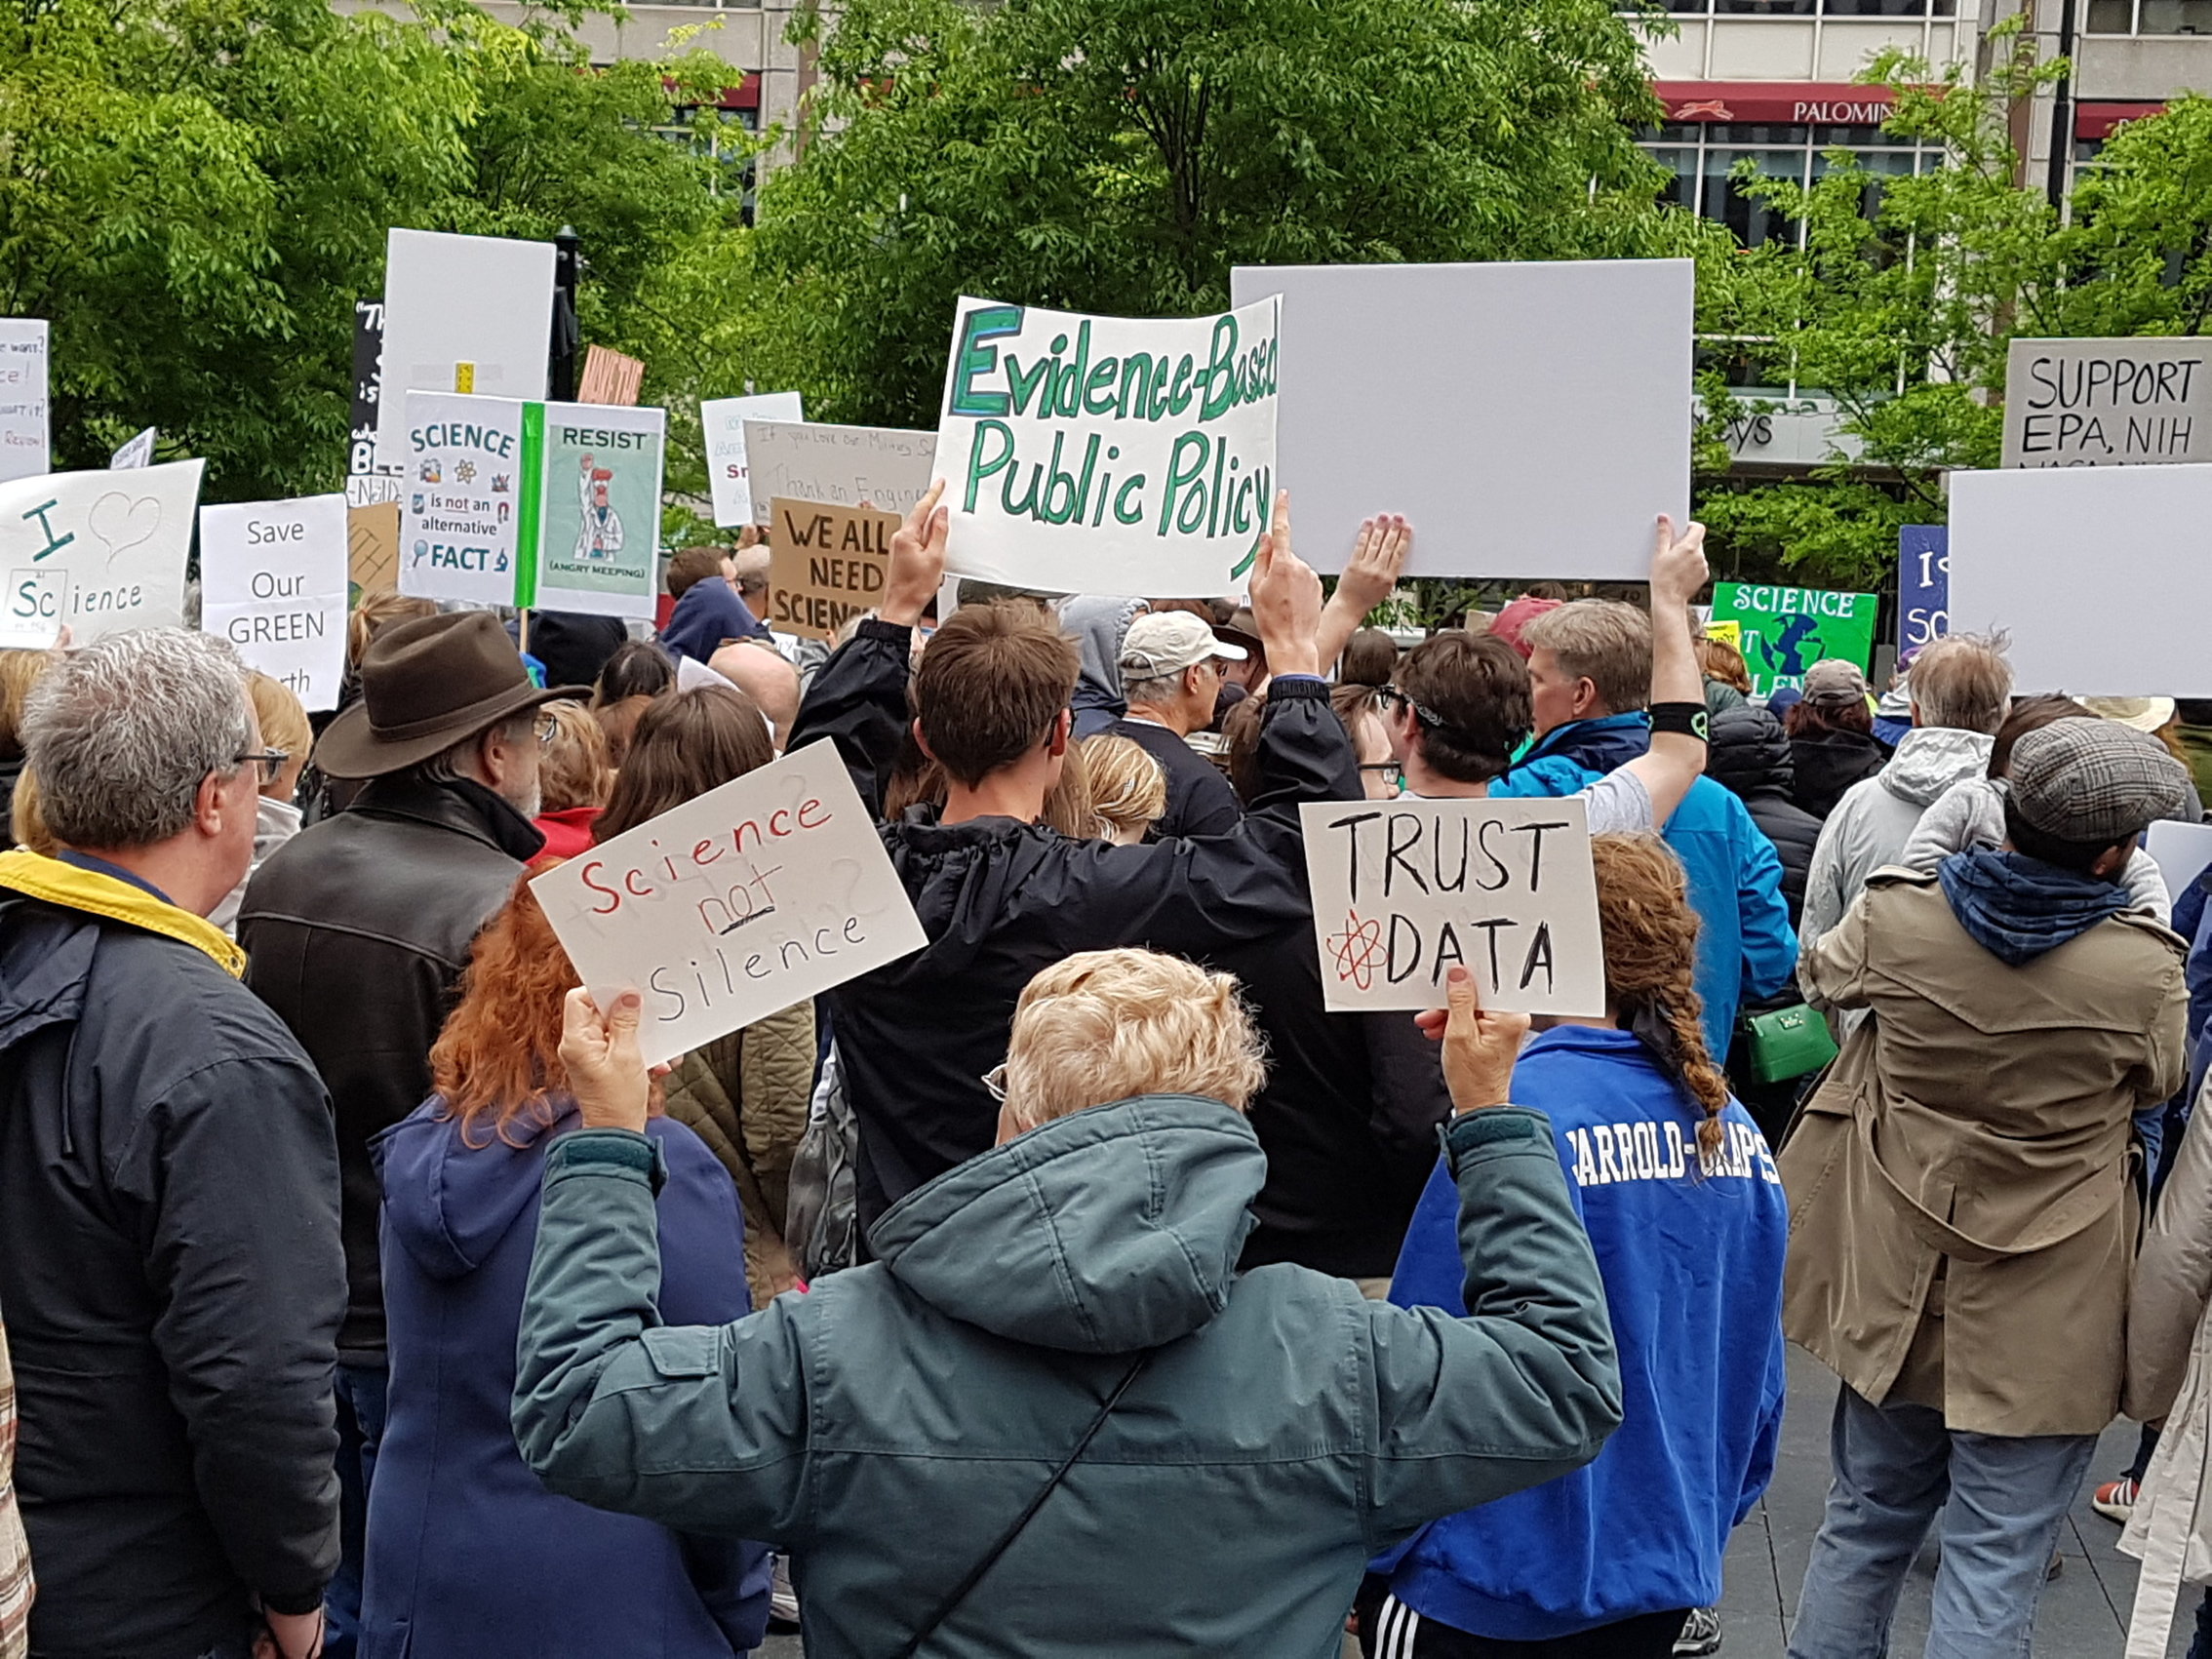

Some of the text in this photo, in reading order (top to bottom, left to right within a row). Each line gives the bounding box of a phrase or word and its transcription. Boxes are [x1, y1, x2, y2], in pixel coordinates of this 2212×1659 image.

[948, 299, 1279, 423] Evidence-Based
[2028, 357, 2203, 409] SUPPORT
[410, 423, 516, 459] SCIENCE
[562, 427, 649, 451] RESIST
[2022, 414, 2192, 454] EPA, NIH
[430, 493, 491, 512] is not an
[962, 420, 1270, 581] Public Policy
[21, 498, 75, 563] I
[247, 520, 305, 545] Save
[421, 517, 498, 536] alternative
[783, 510, 889, 556] WE ALL
[430, 543, 491, 572] FACT
[810, 557, 884, 593] NEED
[251, 572, 305, 600] Our
[1732, 584, 1856, 618] SCIENCE
[227, 611, 325, 644] GREEN
[773, 588, 871, 631] SCIEN
[580, 797, 833, 915] Science
[1327, 810, 1571, 905] TRUST
[696, 864, 784, 934] not
[649, 915, 866, 1022] Silence
[1386, 913, 1555, 995] DATA
